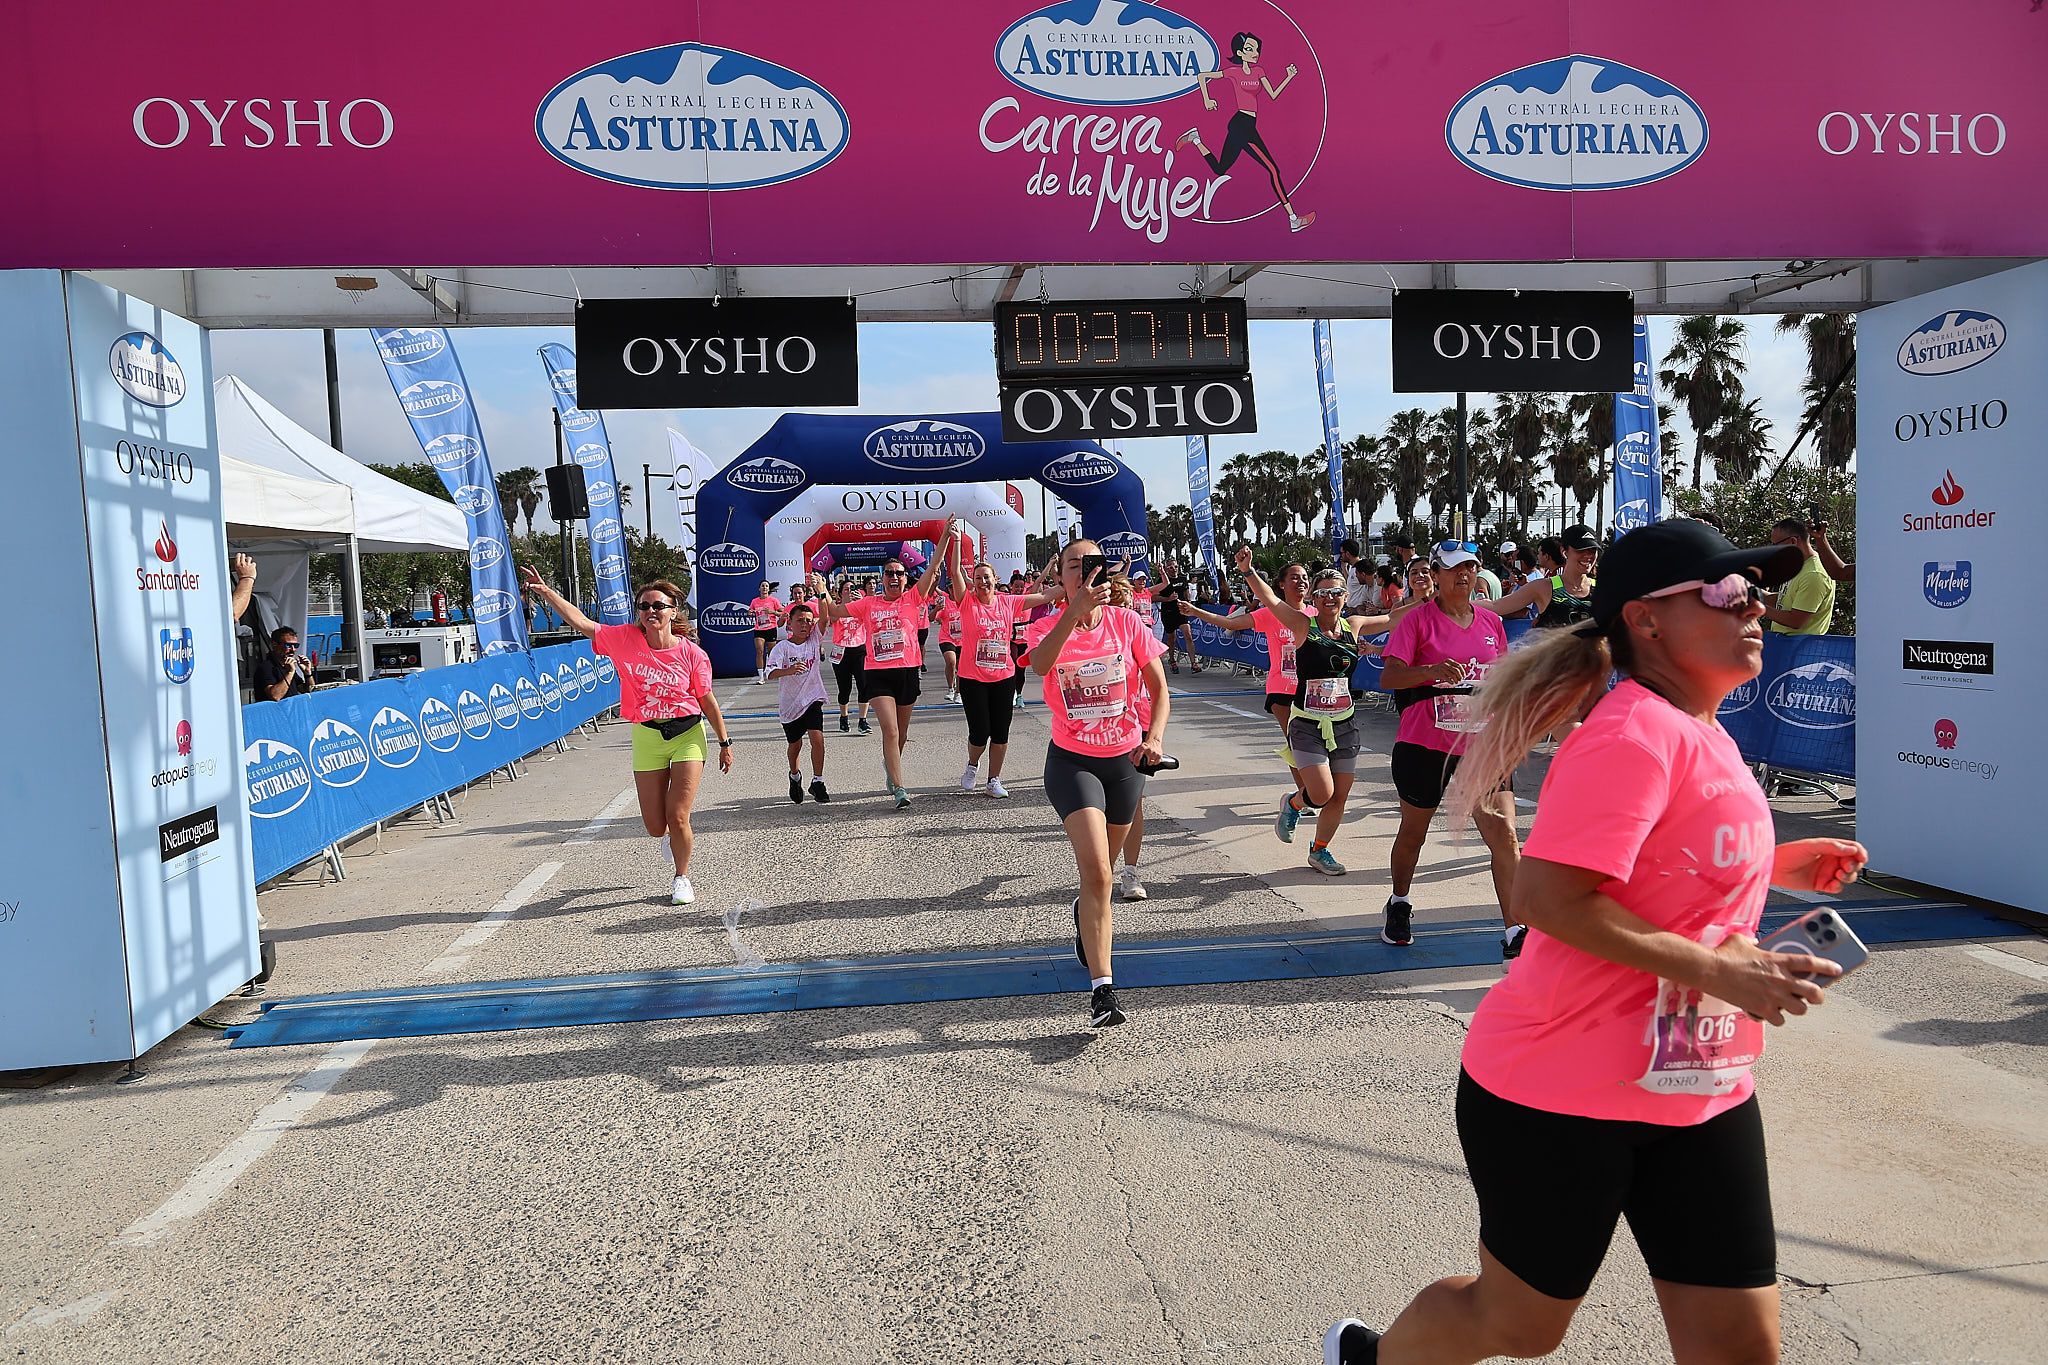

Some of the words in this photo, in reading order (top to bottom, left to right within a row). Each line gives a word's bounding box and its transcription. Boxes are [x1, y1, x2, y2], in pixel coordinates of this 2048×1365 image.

[1047, 33, 1117, 44] CENTRAL
[1125, 34, 1195, 44] LECHERA
[1014, 33, 1202, 77] ASTURIANA
[609, 94, 707, 108] CENTRAL
[718, 96, 814, 110] LECHERA
[1508, 103, 1590, 115] CENTRAL
[1600, 104, 1679, 116] LECHERA
[132, 97, 394, 149] OYSHO
[562, 97, 827, 152] ASTURIANA
[978, 96, 1163, 155] Carrera
[1467, 105, 1689, 155] ASTURIANA
[1817, 111, 2007, 156] OYSHO
[1026, 157, 1060, 197] de
[1068, 156, 1093, 197] la
[1088, 150, 1232, 244] Mujer
[1015, 311, 1230, 365] 00:37:14
[1433, 322, 1601, 361] OYSHO
[1920, 333, 1954, 346] CENTRAL
[1957, 323, 1994, 337] LECHERA
[622, 336, 817, 376] OYSHO
[1904, 333, 1998, 366] ASTURIANA
[116, 349, 182, 396] ASTURIANA
[1014, 382, 1242, 433] OYSHO
[1895, 399, 2008, 442] OYSHO
[873, 436, 977, 458] ASTURIANA
[933, 433, 972, 441] LECHERA
[116, 439, 193, 484] OYSHO
[1049, 463, 1114, 479] ASTURIANA
[732, 469, 800, 484] ASTURIANA
[842, 489, 946, 512] OYSHO
[779, 516, 812, 525] OYSHO
[976, 509, 1007, 518] OYSHO
[1903, 509, 1996, 532] Santander
[833, 522, 863, 533] Sports
[875, 520, 922, 530] Santander
[702, 555, 757, 568] ASTURIANA
[768, 559, 798, 568] OYSHO
[993, 551, 1023, 560] OYSHO
[137, 567, 200, 591] Santander
[1926, 571, 1969, 596] Marlene
[1908, 645, 1988, 669] Neutrogena
[635, 663, 679, 687] CARRERA
[1083, 685, 1109, 697] 016
[424, 719, 459, 742] ASTURIANA
[320, 741, 339, 752] CENTRAL
[340, 737, 359, 747] LECHERA
[375, 731, 419, 757] ASTURIANA
[248, 765, 274, 780] CENTRAL
[274, 756, 300, 771] LECHERA
[318, 746, 367, 776] ASTURIANA
[1898, 751, 1950, 769] octopus
[1951, 758, 1999, 780] energy
[152, 766, 189, 787] octopus
[163, 819, 215, 852] Neutrogena
[1698, 1014, 1736, 1041] 016
[1664, 1061, 1691, 1069] CARRERA
[1692, 1060, 1701, 1068] DE
[1703, 1060, 1711, 1068] LA
[1657, 1075, 1699, 1087] OYSHO
